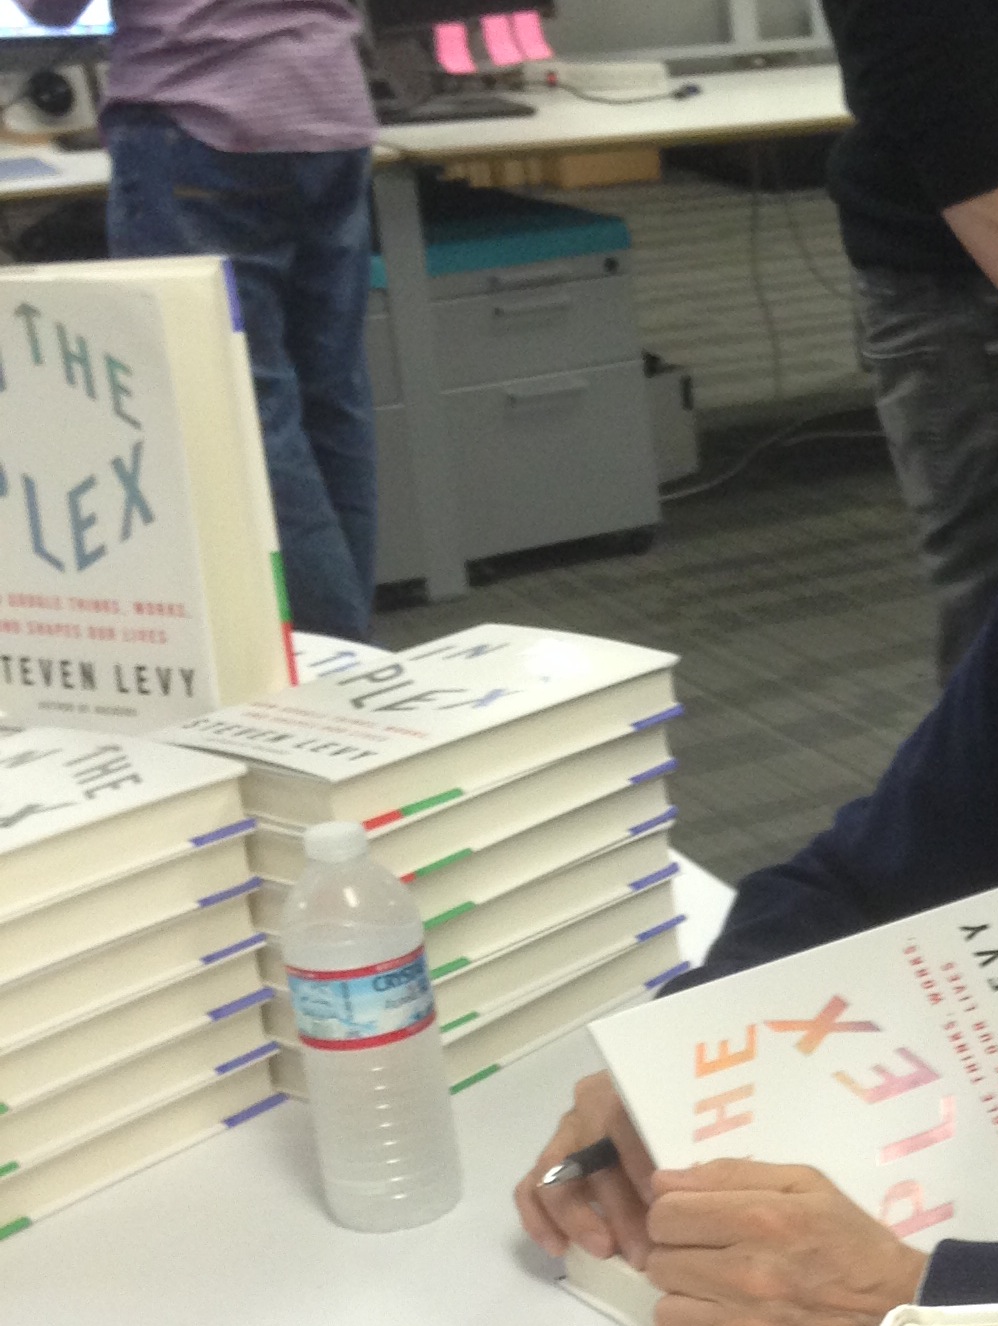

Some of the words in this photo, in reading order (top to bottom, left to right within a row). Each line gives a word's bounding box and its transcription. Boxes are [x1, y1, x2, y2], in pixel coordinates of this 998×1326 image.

[14, 302, 143, 430] THE
[0, 439, 156, 573] LEX
[114, 661, 195, 698] LEVY
[693, 1022, 758, 1166] HE
